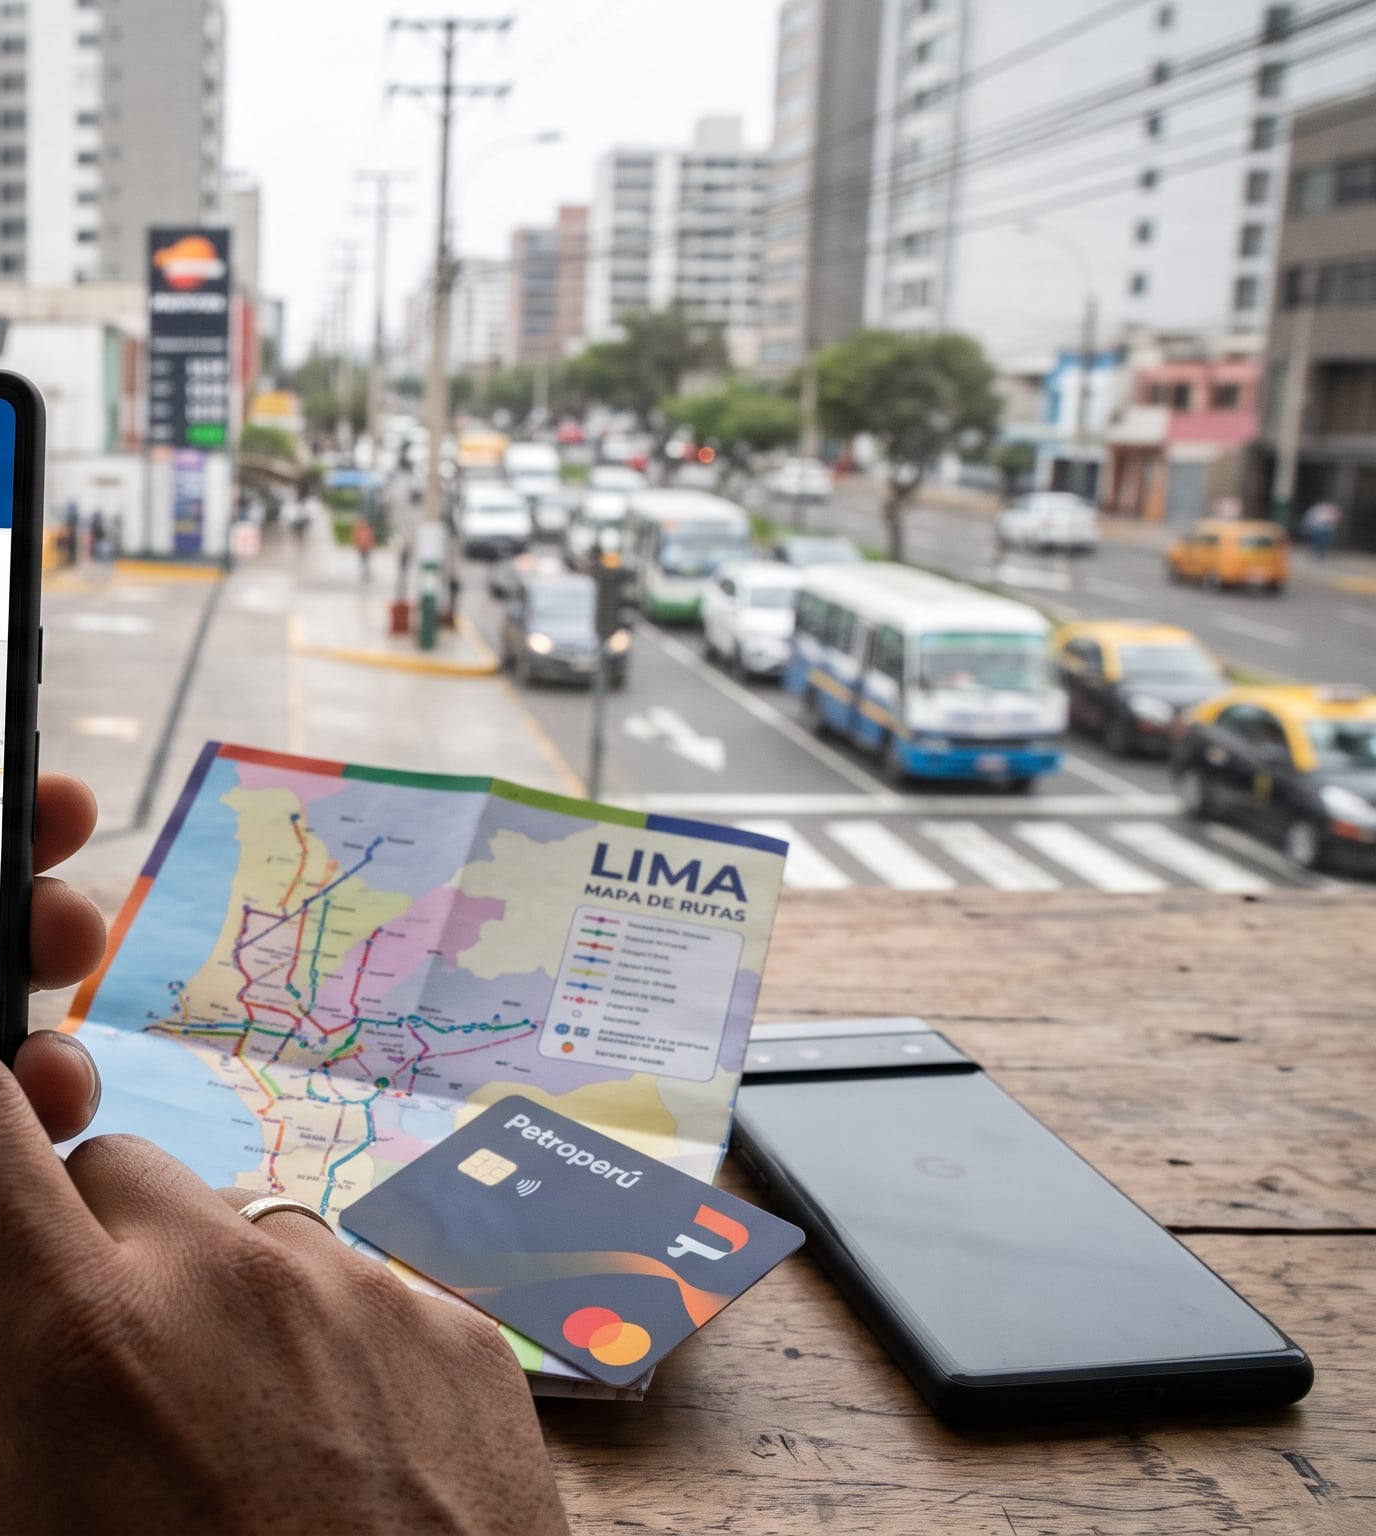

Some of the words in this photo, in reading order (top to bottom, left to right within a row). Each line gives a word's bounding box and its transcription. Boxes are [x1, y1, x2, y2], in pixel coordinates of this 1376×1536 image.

[584, 883, 642, 905] MAPA
[647, 894, 674, 910] DE
[680, 899, 746, 922] RUTAS
[590, 842, 748, 903] LIMA
[504, 1113, 644, 1189] Petroperú
